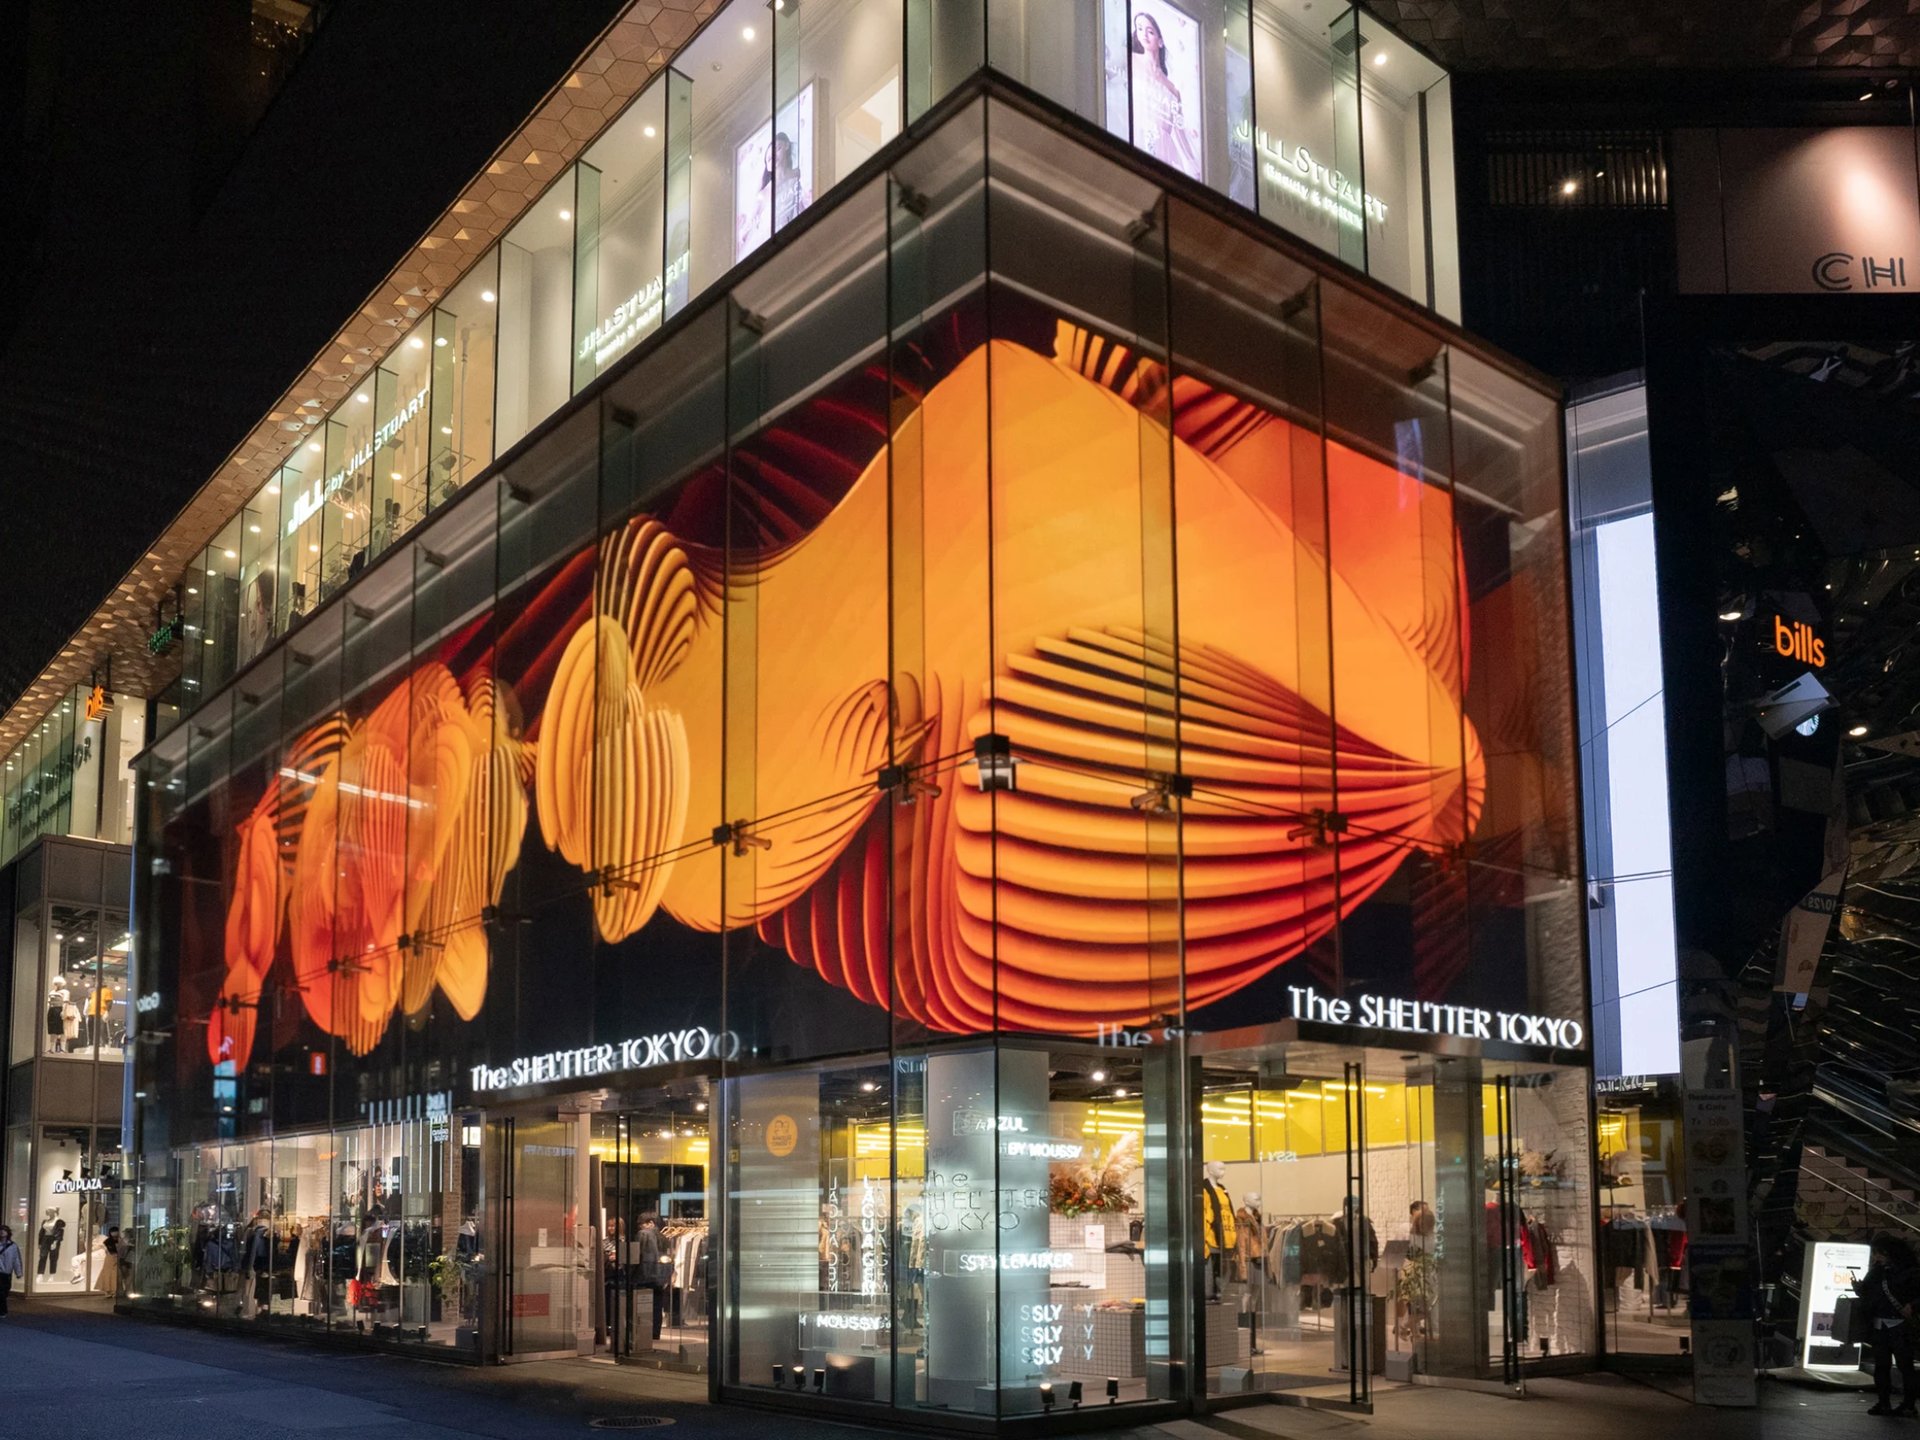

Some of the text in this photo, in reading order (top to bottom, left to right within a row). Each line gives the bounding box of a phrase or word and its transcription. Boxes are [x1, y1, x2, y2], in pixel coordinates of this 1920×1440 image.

[1775, 614, 1825, 668] bills
[1288, 985, 1583, 1049] The SHEL'TTER TOKYO
[471, 1026, 710, 1092] The SHEL'TTER TOKYO
[76, 1178, 103, 1191] PLAZA
[1032, 1304, 1063, 1322] SLY
[1032, 1325, 1063, 1344] SLY
[1032, 1346, 1063, 1365] SLY
